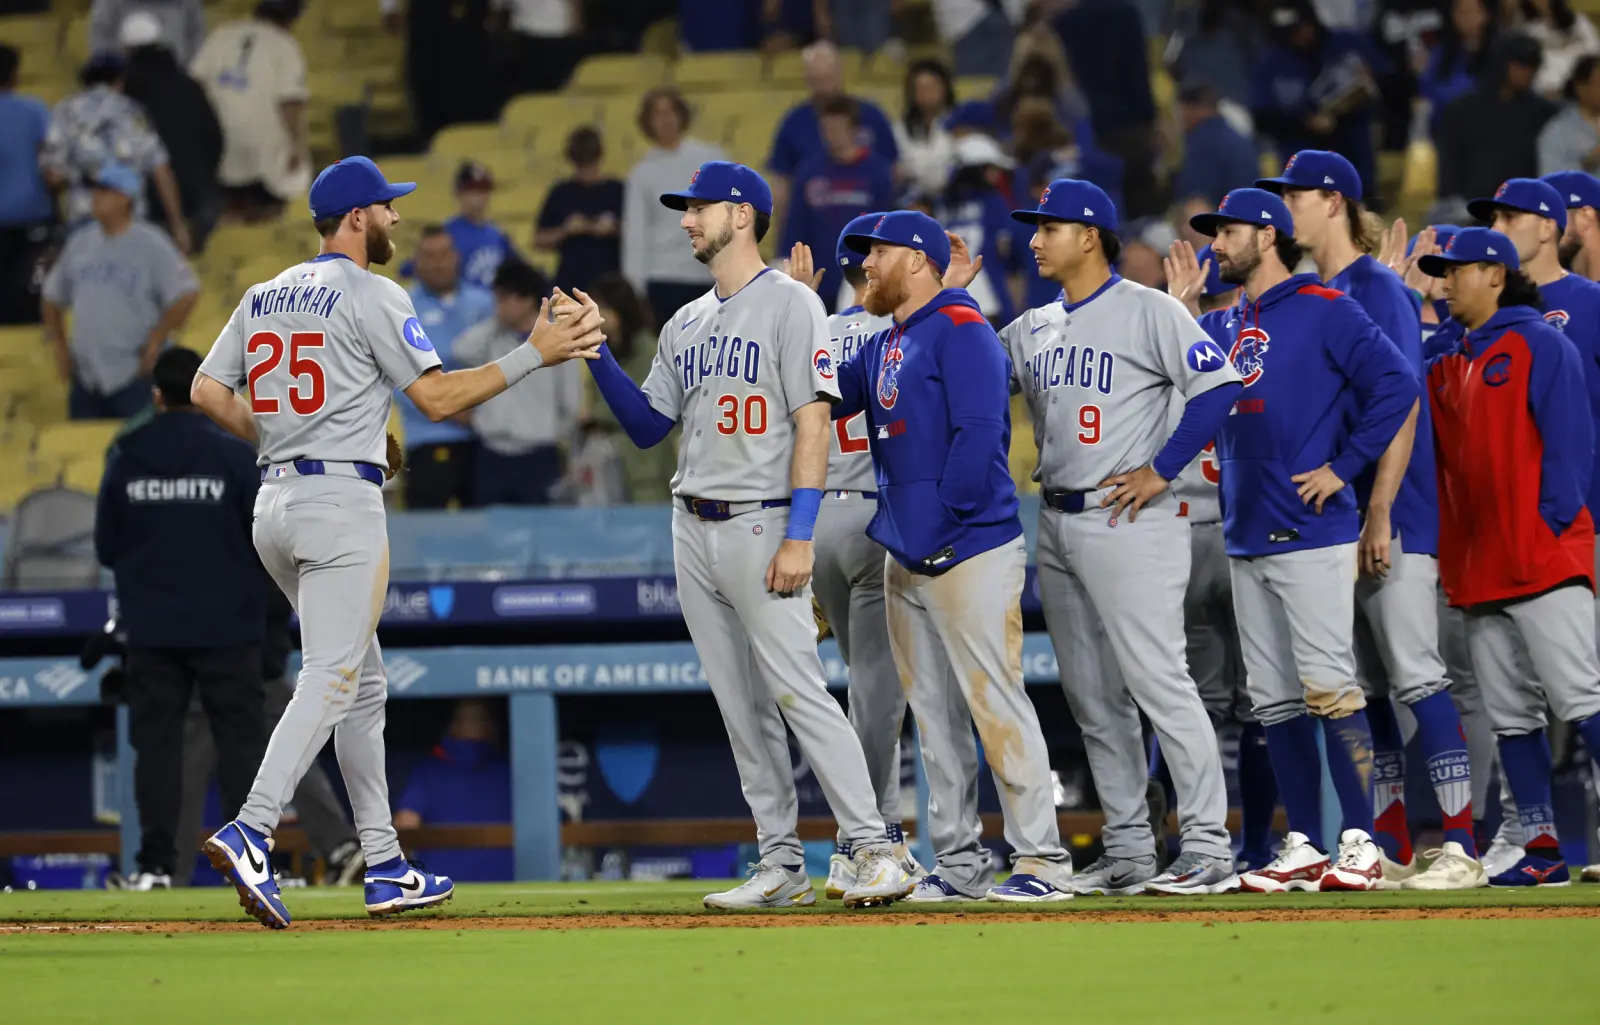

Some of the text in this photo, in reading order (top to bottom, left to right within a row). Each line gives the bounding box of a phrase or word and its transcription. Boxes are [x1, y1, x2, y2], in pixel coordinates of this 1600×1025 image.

[250, 285, 343, 320] WORKMAN
[247, 330, 326, 417] 25
[715, 394, 768, 436] 30
[1078, 404, 1102, 446] 9
[476, 665, 549, 688] BANK
[554, 664, 588, 688] OF
